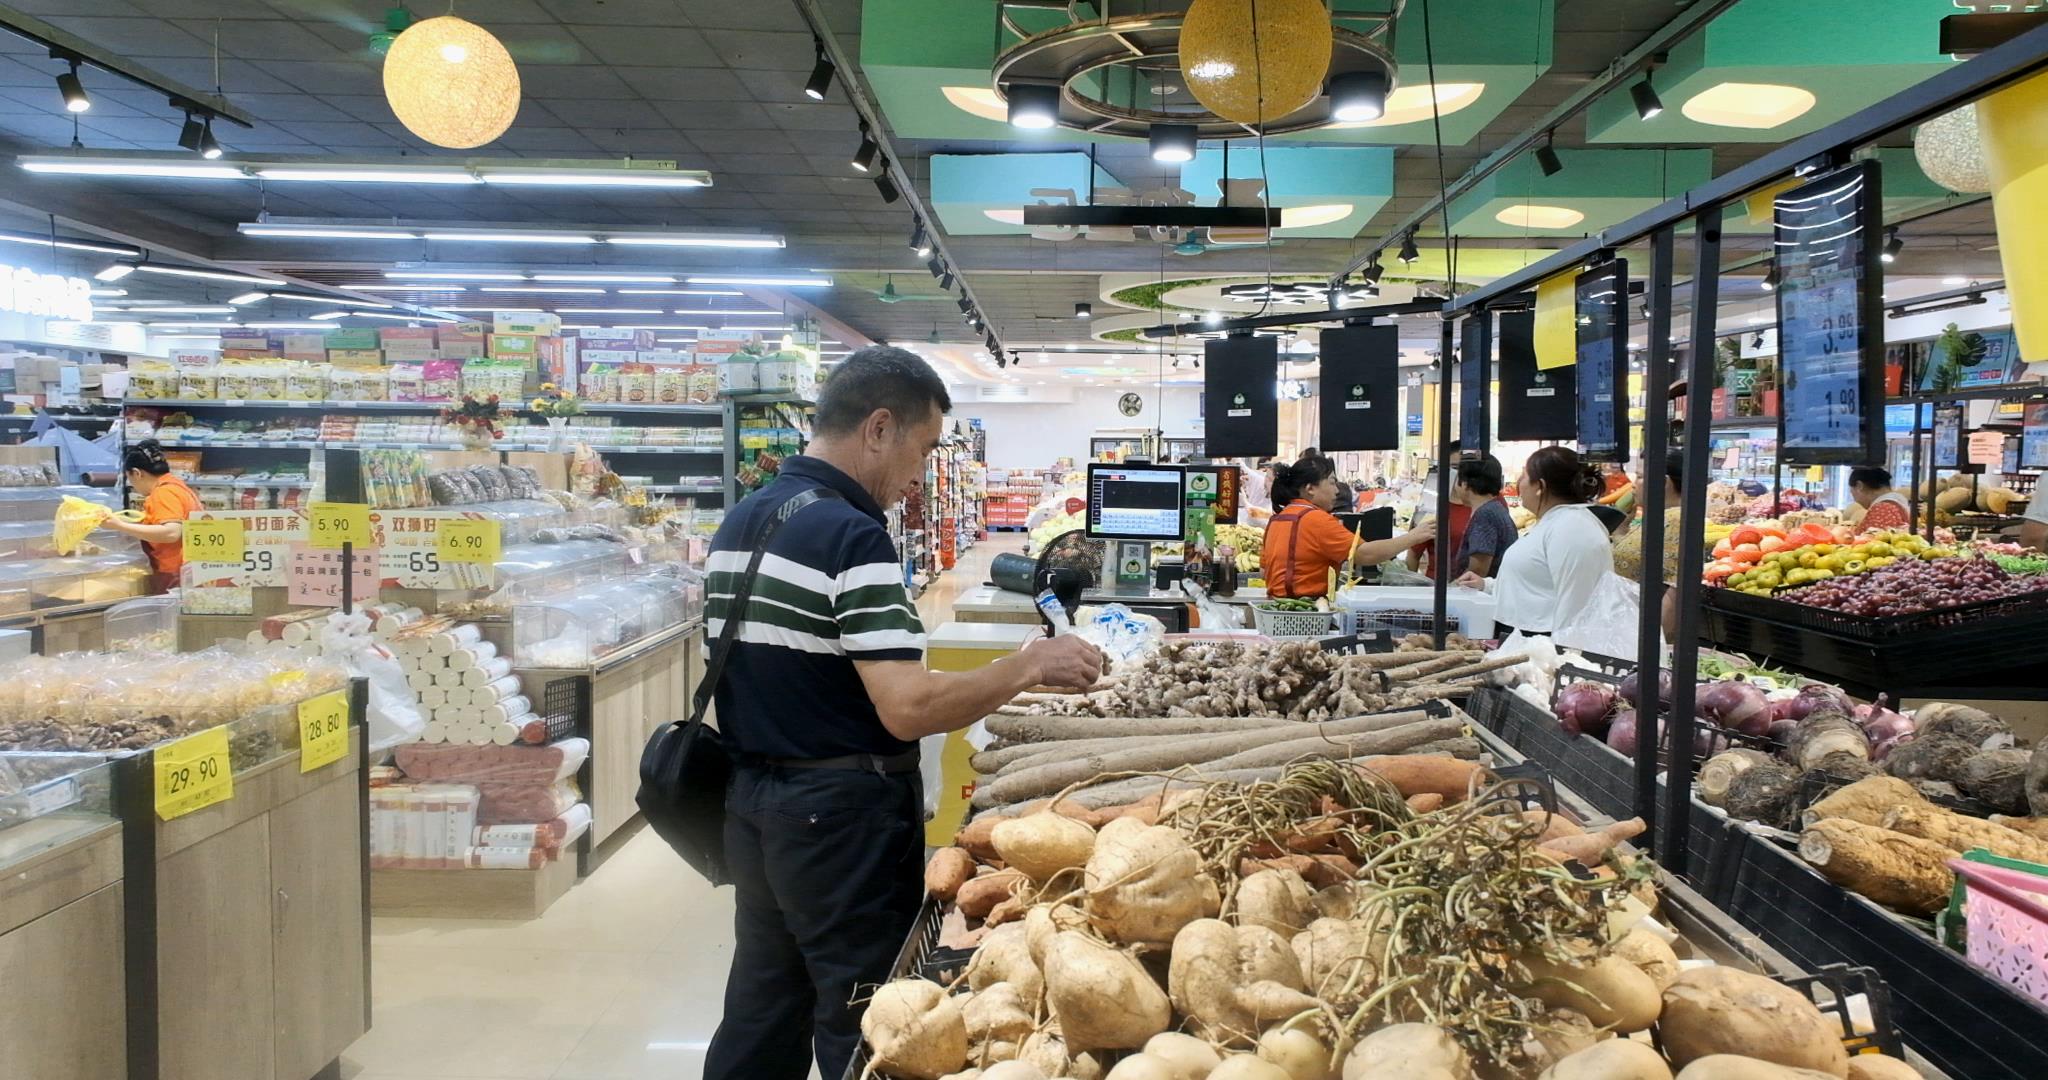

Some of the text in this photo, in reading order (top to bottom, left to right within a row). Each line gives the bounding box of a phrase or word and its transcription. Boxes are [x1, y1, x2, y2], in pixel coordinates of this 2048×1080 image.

[1825, 388, 1856, 428] 1.98
[223, 516, 300, 531] 狮好面条
[318, 518, 349, 531] 5.90
[193, 534, 225, 547] 5.90
[449, 535, 483, 548] 6.90
[309, 712, 341, 741] 28.80
[170, 756, 218, 795] 29.90
